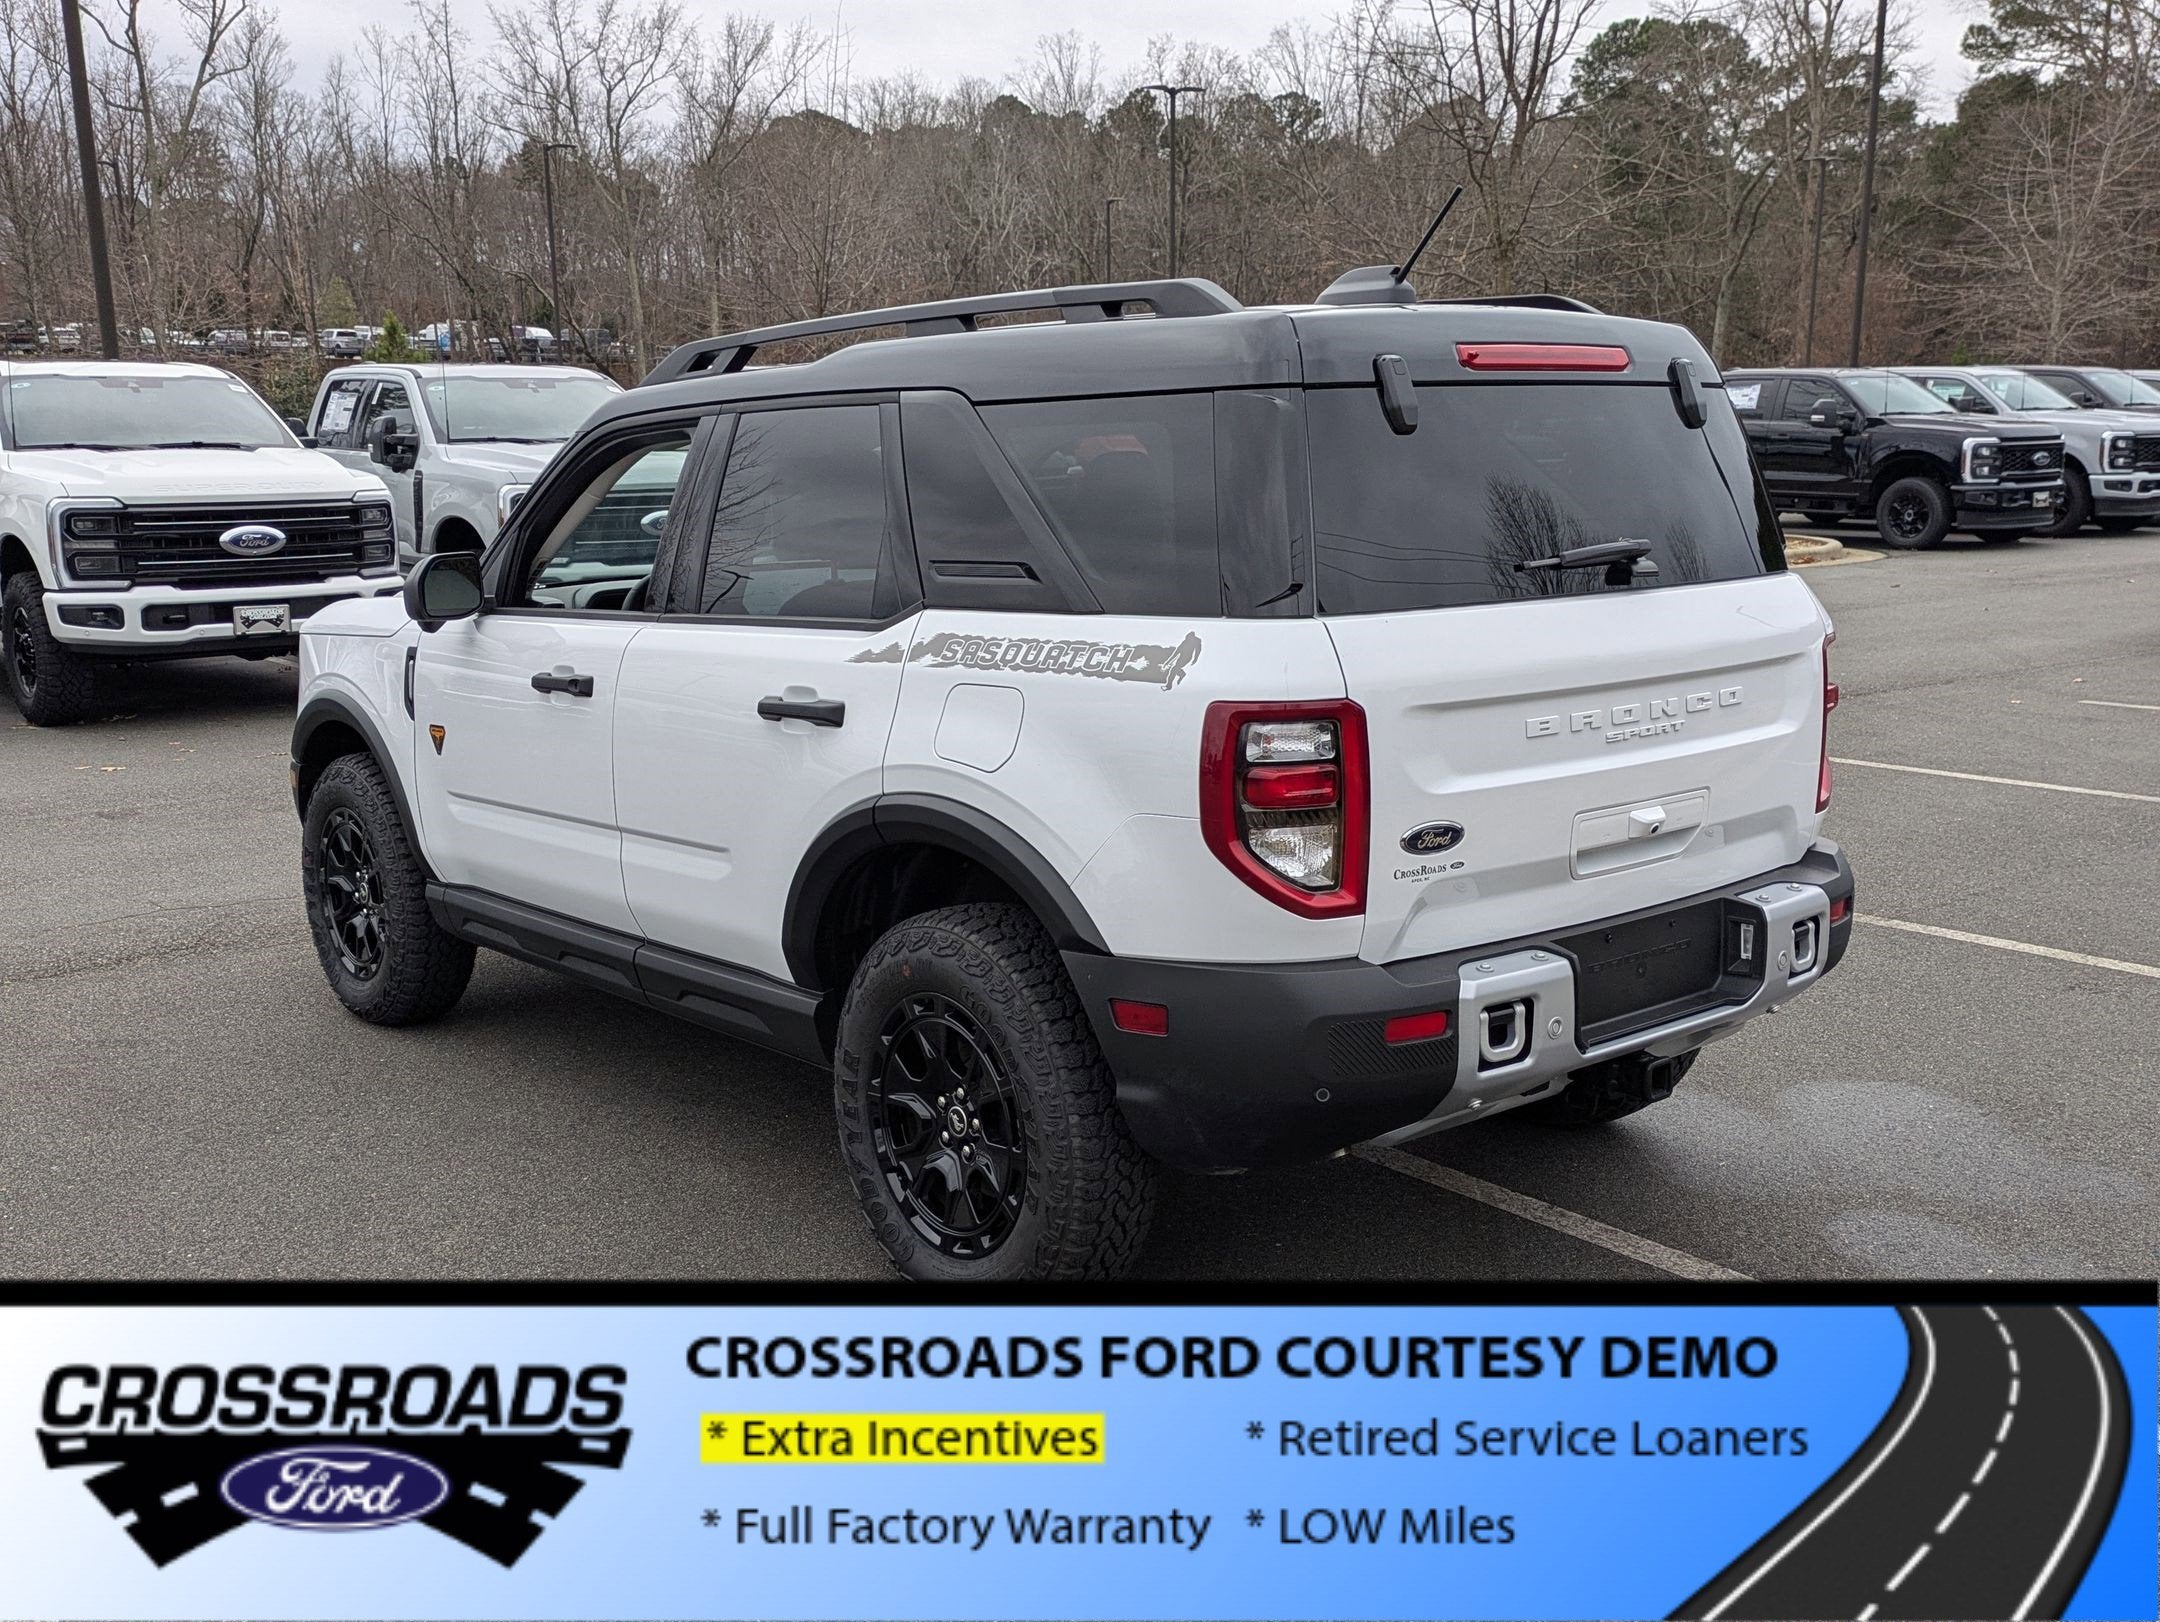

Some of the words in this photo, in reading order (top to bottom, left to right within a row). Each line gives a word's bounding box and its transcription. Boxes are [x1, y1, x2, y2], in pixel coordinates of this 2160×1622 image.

[240, 534, 269, 547] Ford
[940, 638, 1135, 673] SASQUATCH
[1525, 686, 1743, 738] BRONCO
[1605, 719, 1686, 743] SPORT
[1417, 828, 1453, 849] Ford
